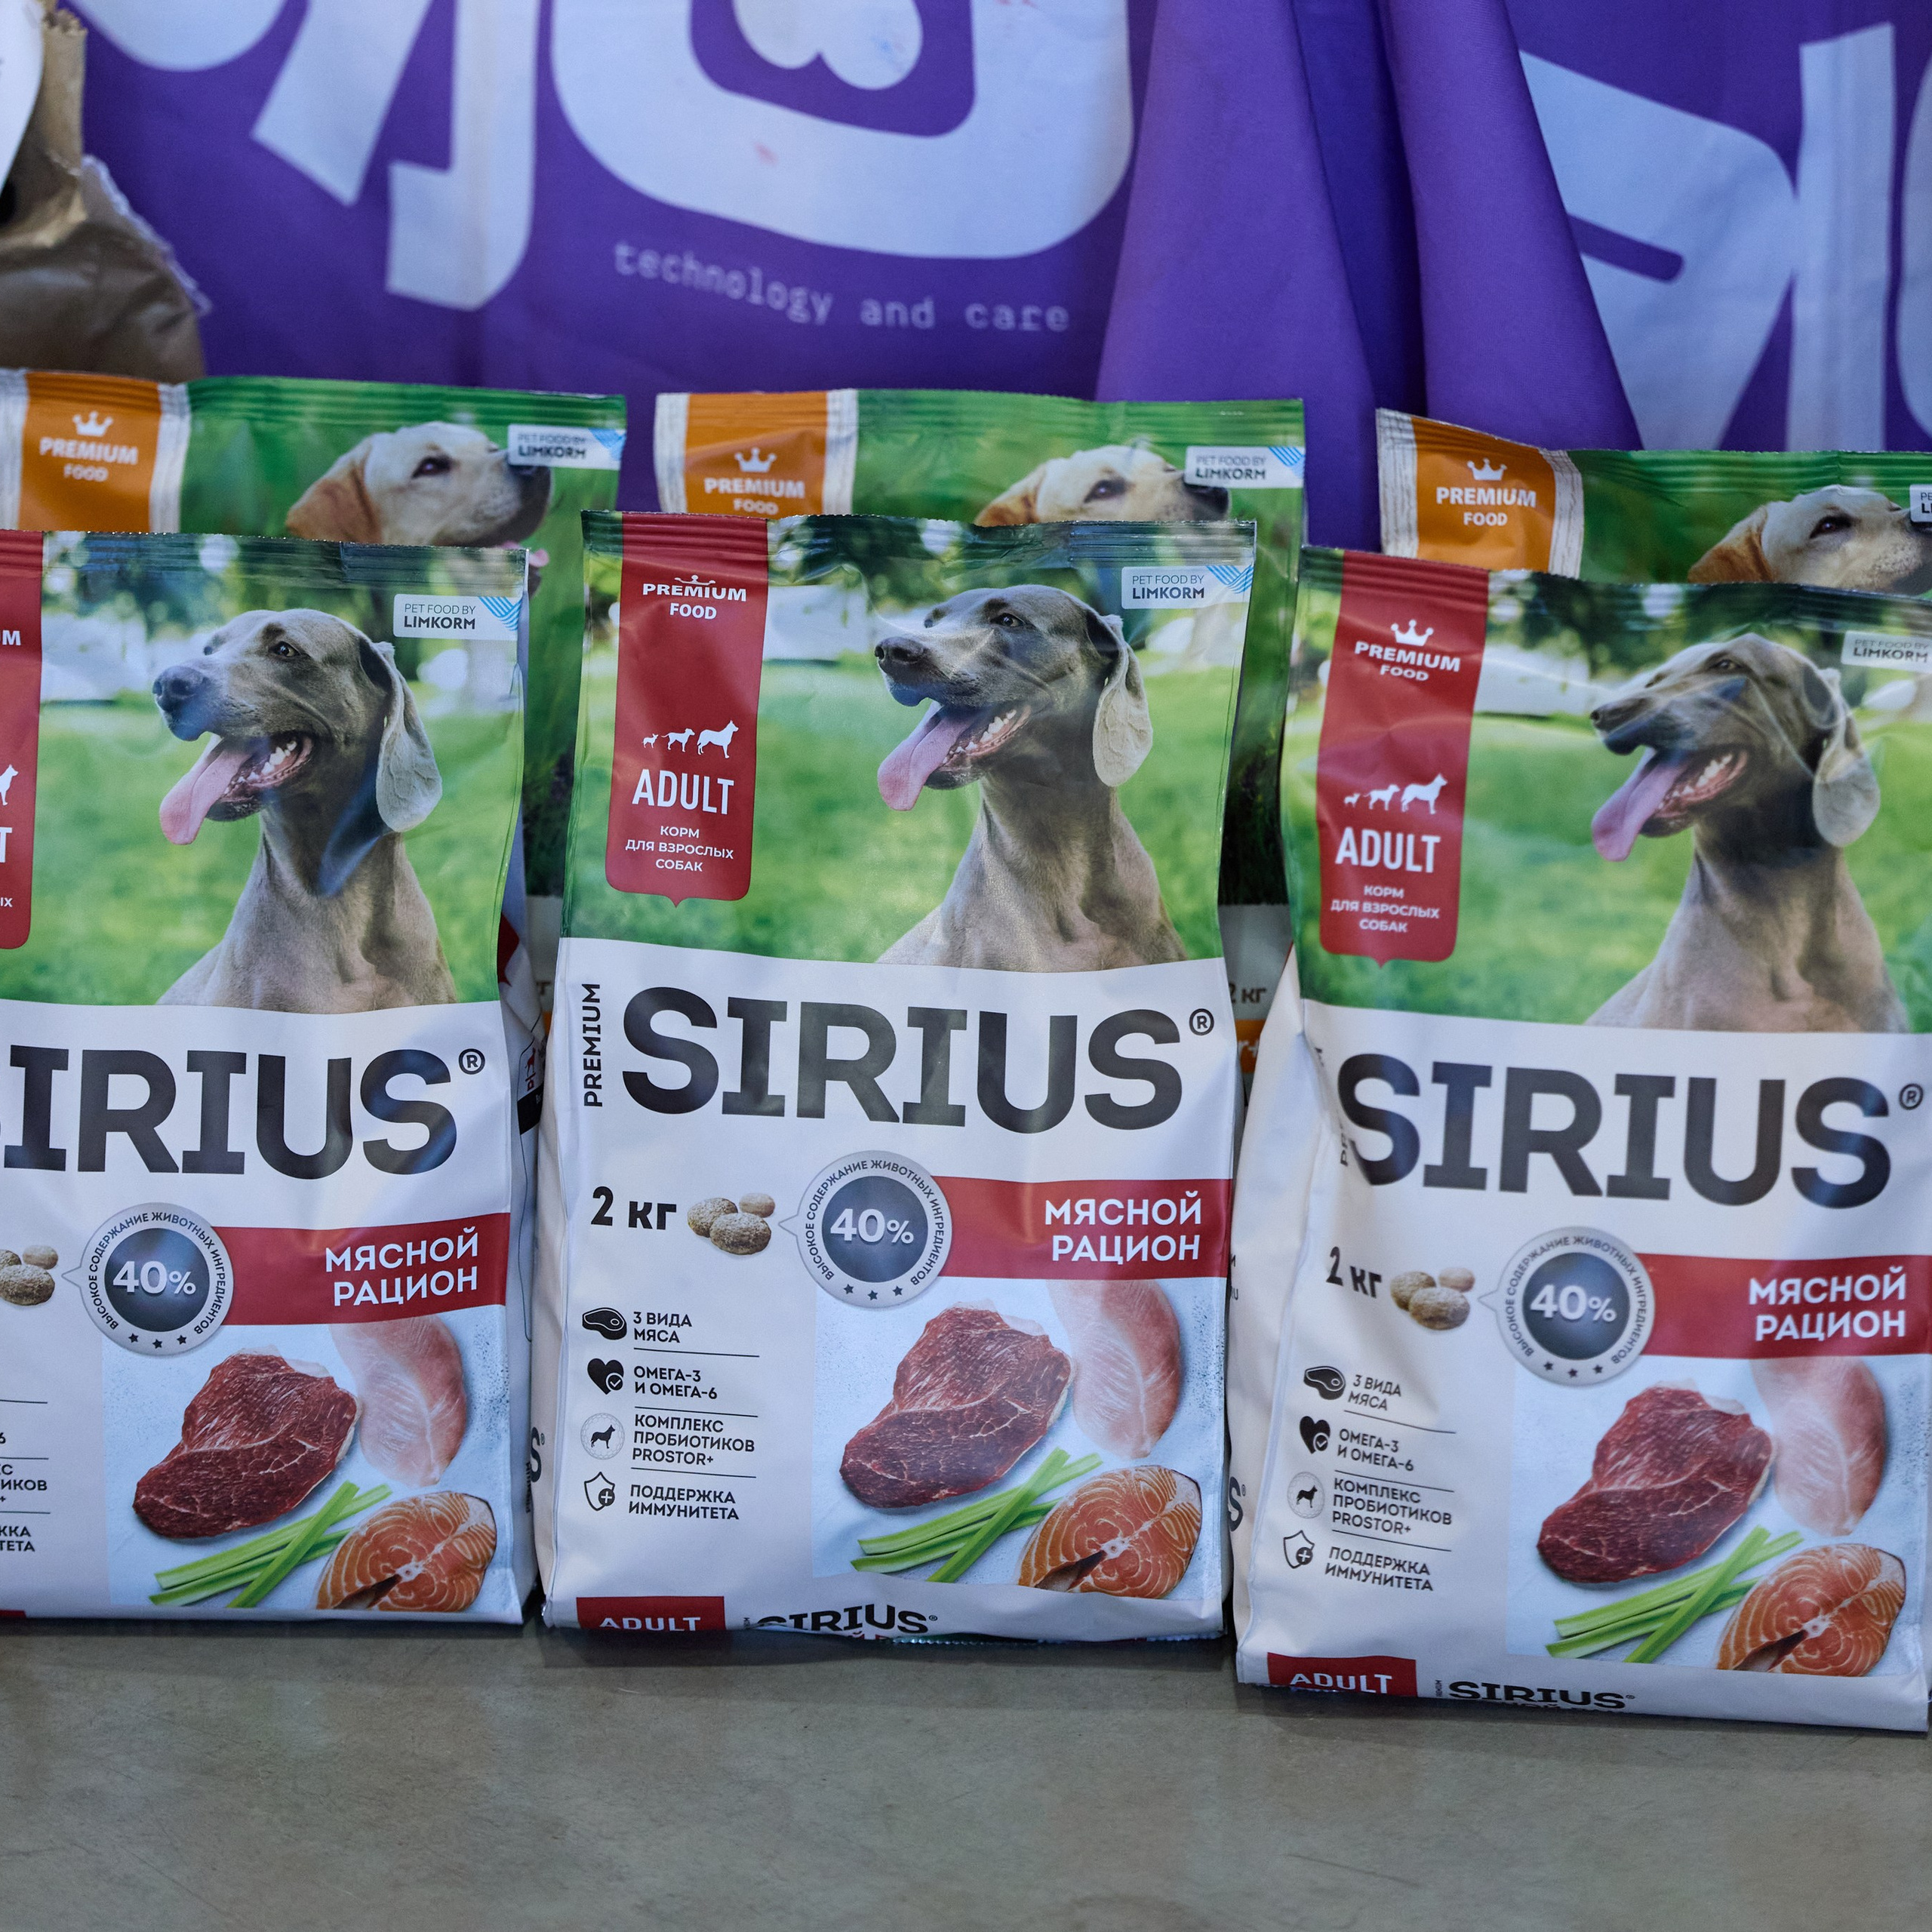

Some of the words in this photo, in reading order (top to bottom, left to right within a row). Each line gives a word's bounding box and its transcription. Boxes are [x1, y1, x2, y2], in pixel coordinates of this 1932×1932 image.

[614, 240, 832, 325] technology
[860, 297, 936, 328] and
[964, 302, 1070, 332] care
[39, 436, 139, 465] PREMIUM
[518, 445, 586, 459] LIMKORM
[1196, 456, 1216, 466] PET
[1218, 456, 1249, 466] FOOD
[1252, 456, 1266, 466] BY
[63, 463, 109, 482] FOOD
[1195, 468, 1266, 480] LIMKORM
[703, 477, 805, 499] PREMIUM
[1436, 486, 1537, 508] PREMIUM
[733, 497, 780, 515] FOOD
[1463, 512, 1508, 527] FOOD
[1132, 575, 1152, 585] PET
[1155, 575, 1188, 585] FOOD
[1190, 575, 1204, 584] BY
[642, 583, 747, 602] PREMIUM
[1132, 587, 1204, 599] LIMKORM
[404, 603, 424, 614] PET
[427, 604, 460, 615] FOOD
[462, 605, 476, 616] BY
[669, 602, 717, 620] FOOD
[404, 616, 475, 630] LIMKORM
[1354, 641, 1461, 672] PREMIUM
[1853, 647, 1929, 663] LIMKORM
[1854, 638, 1875, 649] PET
[1878, 639, 1911, 649] FOOD
[1914, 642, 1929, 651] BY
[1379, 664, 1429, 681] FOOD
[632, 768, 735, 816] ADULT
[660, 825, 700, 839] КОРМ
[625, 838, 655, 852] ДЛЯ
[658, 841, 734, 860] ВЗРОСЛЫХ
[1335, 827, 1441, 873] ADULT
[655, 858, 703, 872] СОБАК
[1364, 884, 1404, 899] КОРМ
[1330, 899, 1360, 912] ДЛЯ
[1363, 901, 1441, 918] ВЗРОСЛЫХ
[1358, 917, 1409, 932] СОБАК
[1241, 986, 1267, 1004] кг
[584, 983, 601, 1107] PREMIUM
[807, 1160, 868, 1220] СОДЕРЖАНИЕ
[870, 1159, 934, 1198] ЖИВОТНЫХ
[591, 1186, 614, 1226] 2
[628, 1201, 677, 1230] кг
[1045, 1191, 1203, 1226] МЯСНОЙ
[151, 1211, 215, 1250] ЖИВОТНЫХ
[830, 1208, 915, 1244] 40%
[89, 1212, 149, 1272] СОДЕРЖАНИЕ
[325, 1226, 479, 1273] МЯСНОЙ
[805, 1223, 835, 1281] ВЫСОКОЕ
[910, 1198, 945, 1285] ИНГРЕДИЕНТОВ
[1052, 1235, 1201, 1263] РАЦИОН
[1507, 1236, 1570, 1297] СОДЕРЖАНИЕ
[1573, 1235, 1637, 1275] ЖИВОТНЫХ
[112, 1260, 197, 1296] 40%
[1326, 1246, 1344, 1287] 2
[1349, 1265, 1382, 1299] кг
[193, 1249, 226, 1335] ИНГРЕДИЕНТОВ
[333, 1266, 478, 1307] РАЦИОН
[1749, 1268, 1906, 1306] МЯСНОЙ
[88, 1275, 119, 1331] ВЫСОКОЕ
[1530, 1284, 1617, 1322] 40%
[632, 1312, 642, 1324] 3
[646, 1312, 693, 1327] ВИДА
[1506, 1299, 1535, 1358] ВЫСОКОЕ
[1611, 1276, 1647, 1364] ИНГРЕДИЕНТОВ
[1755, 1311, 1906, 1343] РАЦИОН
[633, 1327, 681, 1343] МЯСА
[633, 1365, 701, 1383] ОМЕГА-3
[1352, 1374, 1362, 1388] 3
[1364, 1376, 1402, 1398] ВИДА
[635, 1382, 646, 1394] И
[649, 1383, 718, 1400] ОМЕГА-6
[1348, 1390, 1389, 1411] МЯСА
[634, 1414, 724, 1433] КОМПЛЕКС
[633, 1431, 755, 1453] ПРОБИОТИКОВ
[1339, 1428, 1400, 1454] ОМЕГА-3
[632, 1447, 714, 1466] PROSTOR+
[1337, 1444, 1348, 1459] И
[1351, 1448, 1414, 1472] ОМЕГА-6
[629, 1484, 737, 1504] ПОДДЕРЖКА
[1334, 1477, 1421, 1504] КОМПЛЕКС
[628, 1500, 740, 1520] ИММУНИТЕТА
[1333, 1494, 1453, 1525] ПРОБИОТИКОВ
[1332, 1510, 1412, 1535] PROSTOR+
[1328, 1546, 1431, 1576] ПОДДЕРЖКА
[1324, 1561, 1434, 1592] ИММУНИТЕТА
[598, 1617, 701, 1632] ADULT
[1291, 1672, 1392, 1694] ADULT
